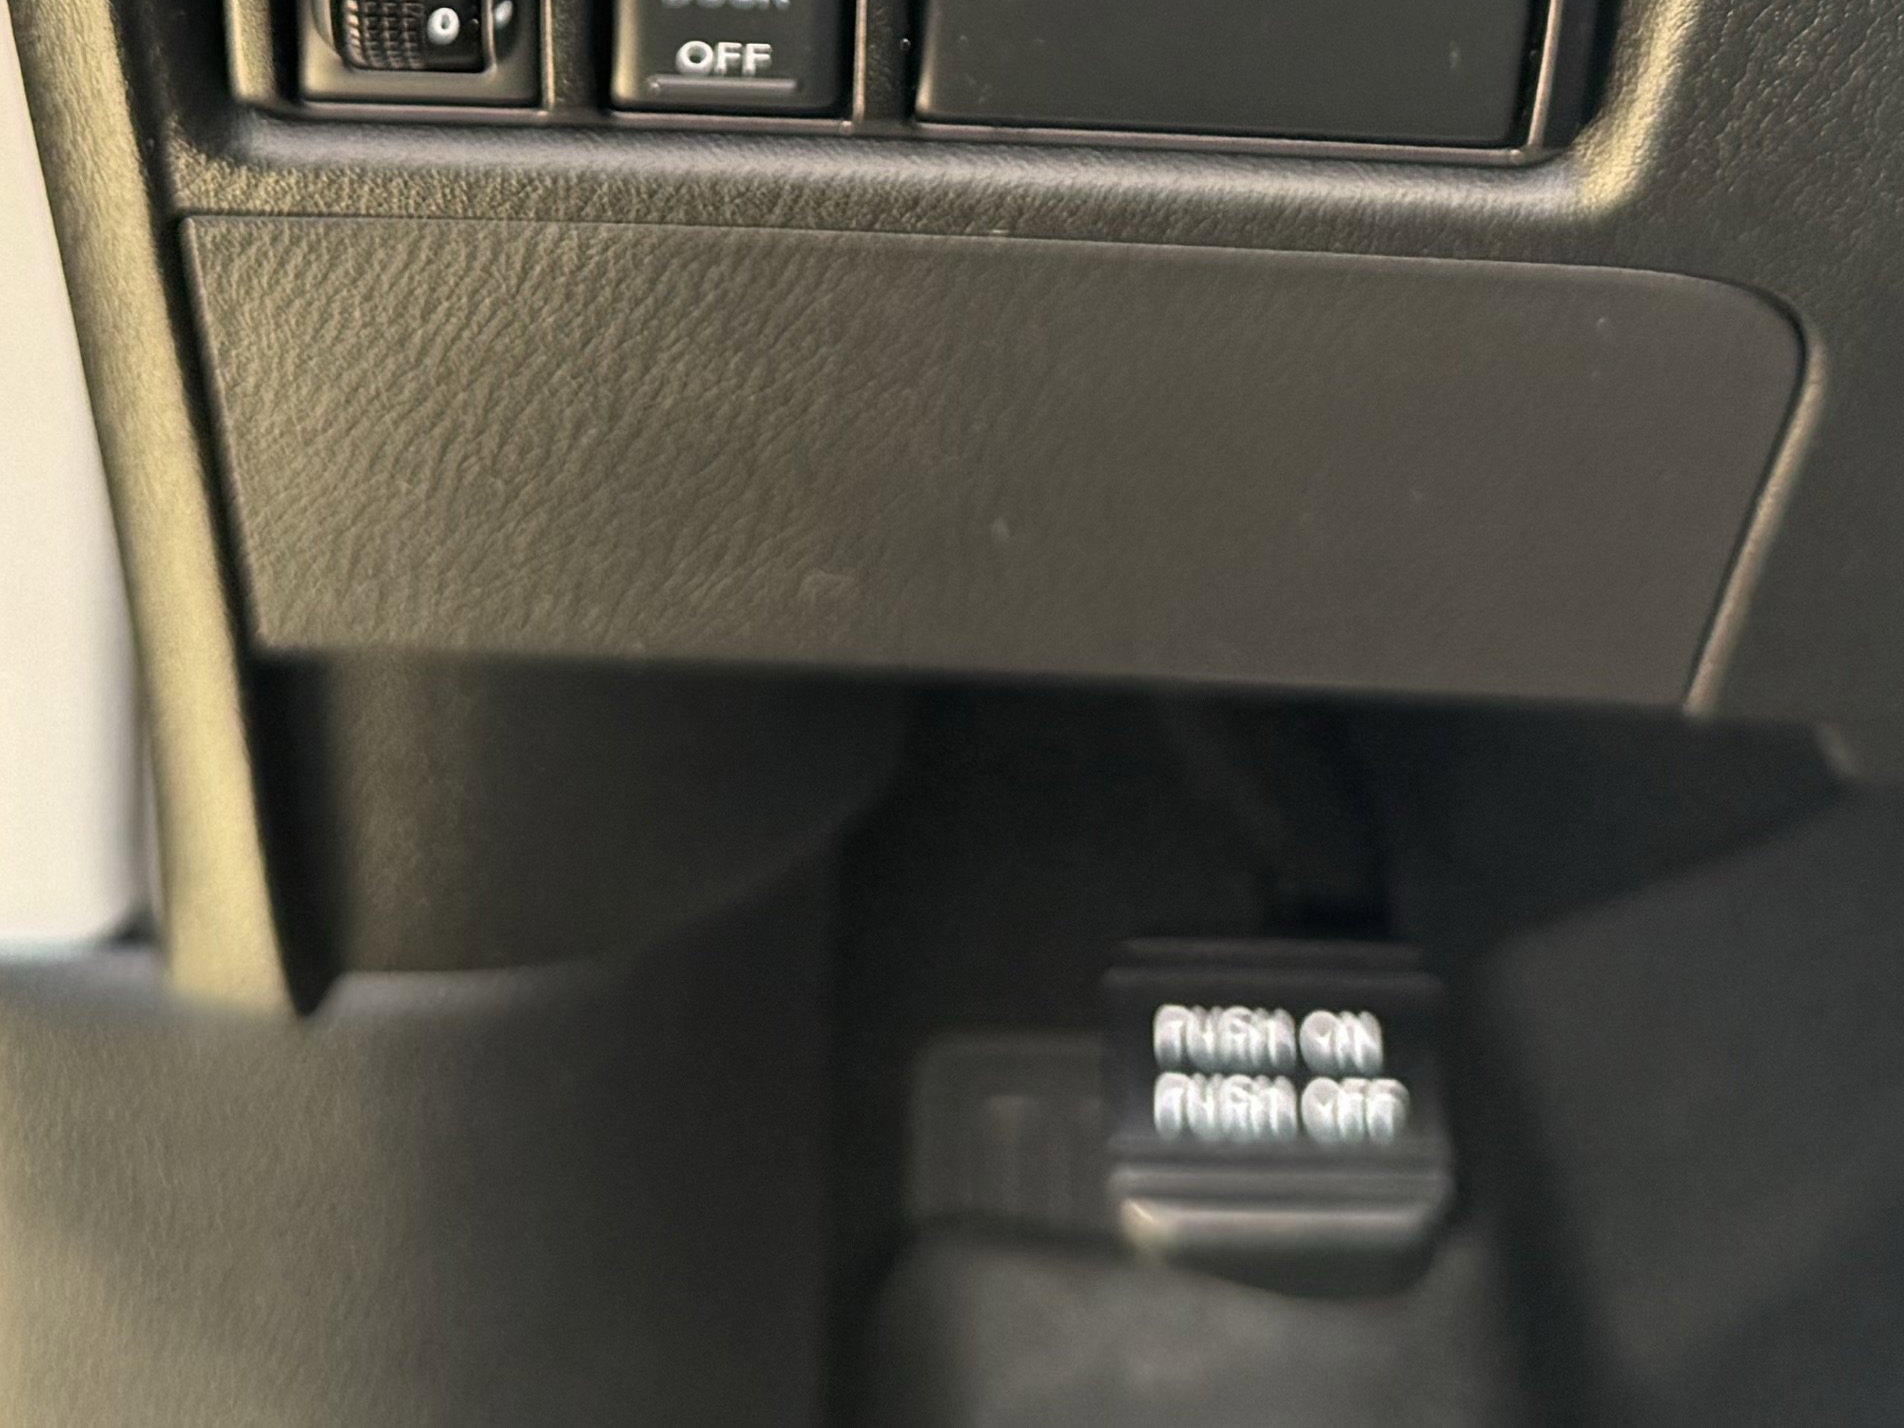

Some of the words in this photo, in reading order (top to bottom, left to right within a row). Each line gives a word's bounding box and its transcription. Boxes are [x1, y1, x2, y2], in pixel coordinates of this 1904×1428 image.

[427, 7, 460, 45] 0
[675, 40, 773, 76] OFF
[1300, 1010, 1384, 1075] ON
[1301, 1077, 1409, 1144] OFF
